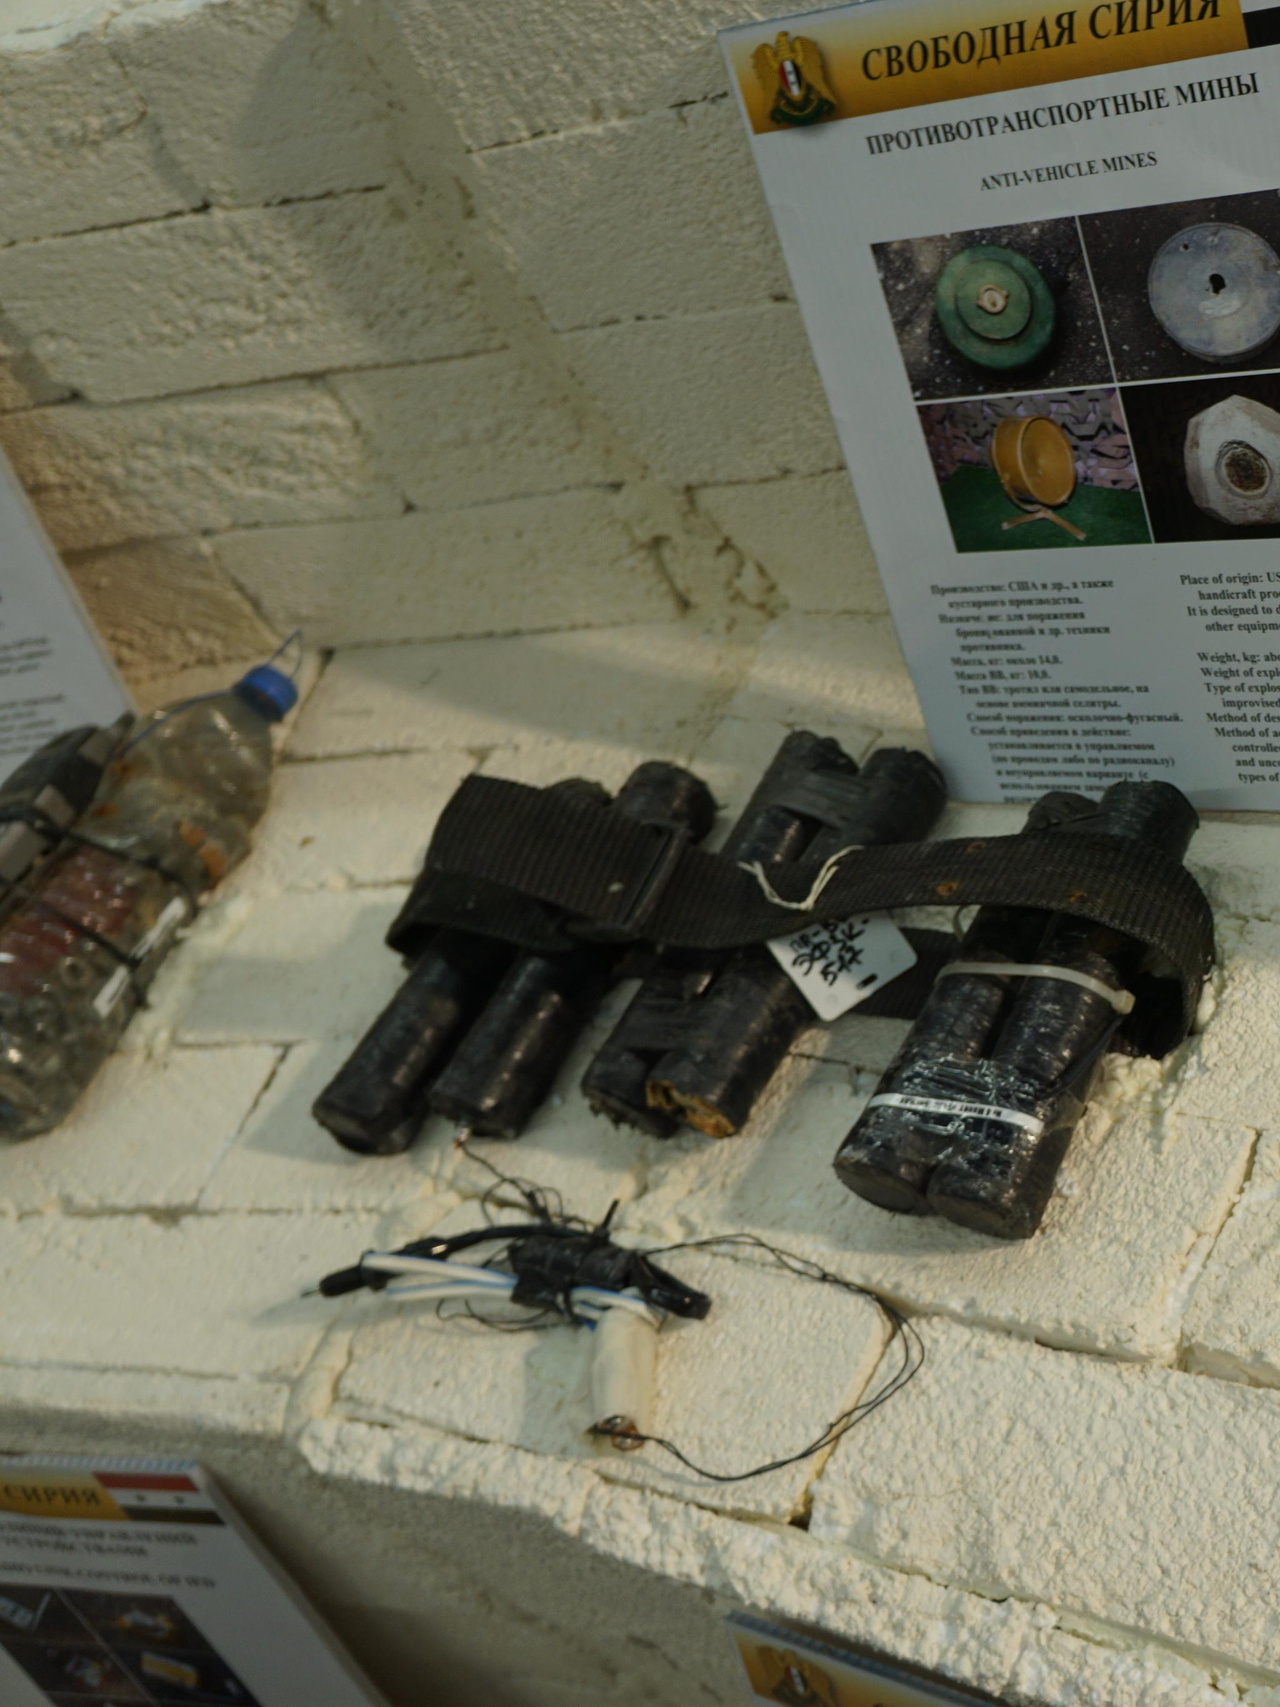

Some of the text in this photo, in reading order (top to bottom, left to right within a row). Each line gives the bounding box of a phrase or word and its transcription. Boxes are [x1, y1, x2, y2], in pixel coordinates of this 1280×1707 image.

[861, 10, 1078, 81] СВОБОДНАЯ
[866, 72, 1260, 155] ПРОТИВОТРАНСПОРТНЫЕ МИНЫ
[980, 152, 1158, 191] ANTI-VEHICLE MINES
[1180, 574, 1209, 585] Place
[1212, 574, 1223, 584] of
[1226, 574, 1263, 584] origin:
[1198, 589, 1256, 600] handicraft
[1187, 606, 1197, 616] It
[1199, 606, 1208, 616] is
[1211, 605, 1258, 617] designed
[1262, 606, 1273, 614] to
[1205, 621, 1233, 631] other
[1197, 653, 1240, 664] Weight,
[1243, 652, 1260, 664] kg:
[1201, 668, 1240, 679] Weight
[1243, 667, 1253, 677] of
[1204, 683, 1232, 694] Type
[1235, 682, 1245, 693] of
[1207, 713, 1247, 723] Method
[1250, 713, 1261, 723] of
[1215, 728, 1256, 738] Method
[1259, 728, 1269, 738] of
[1236, 758, 1255, 767] and
[1238, 772, 1266, 784] types
[1269, 773, 1279, 782] of
